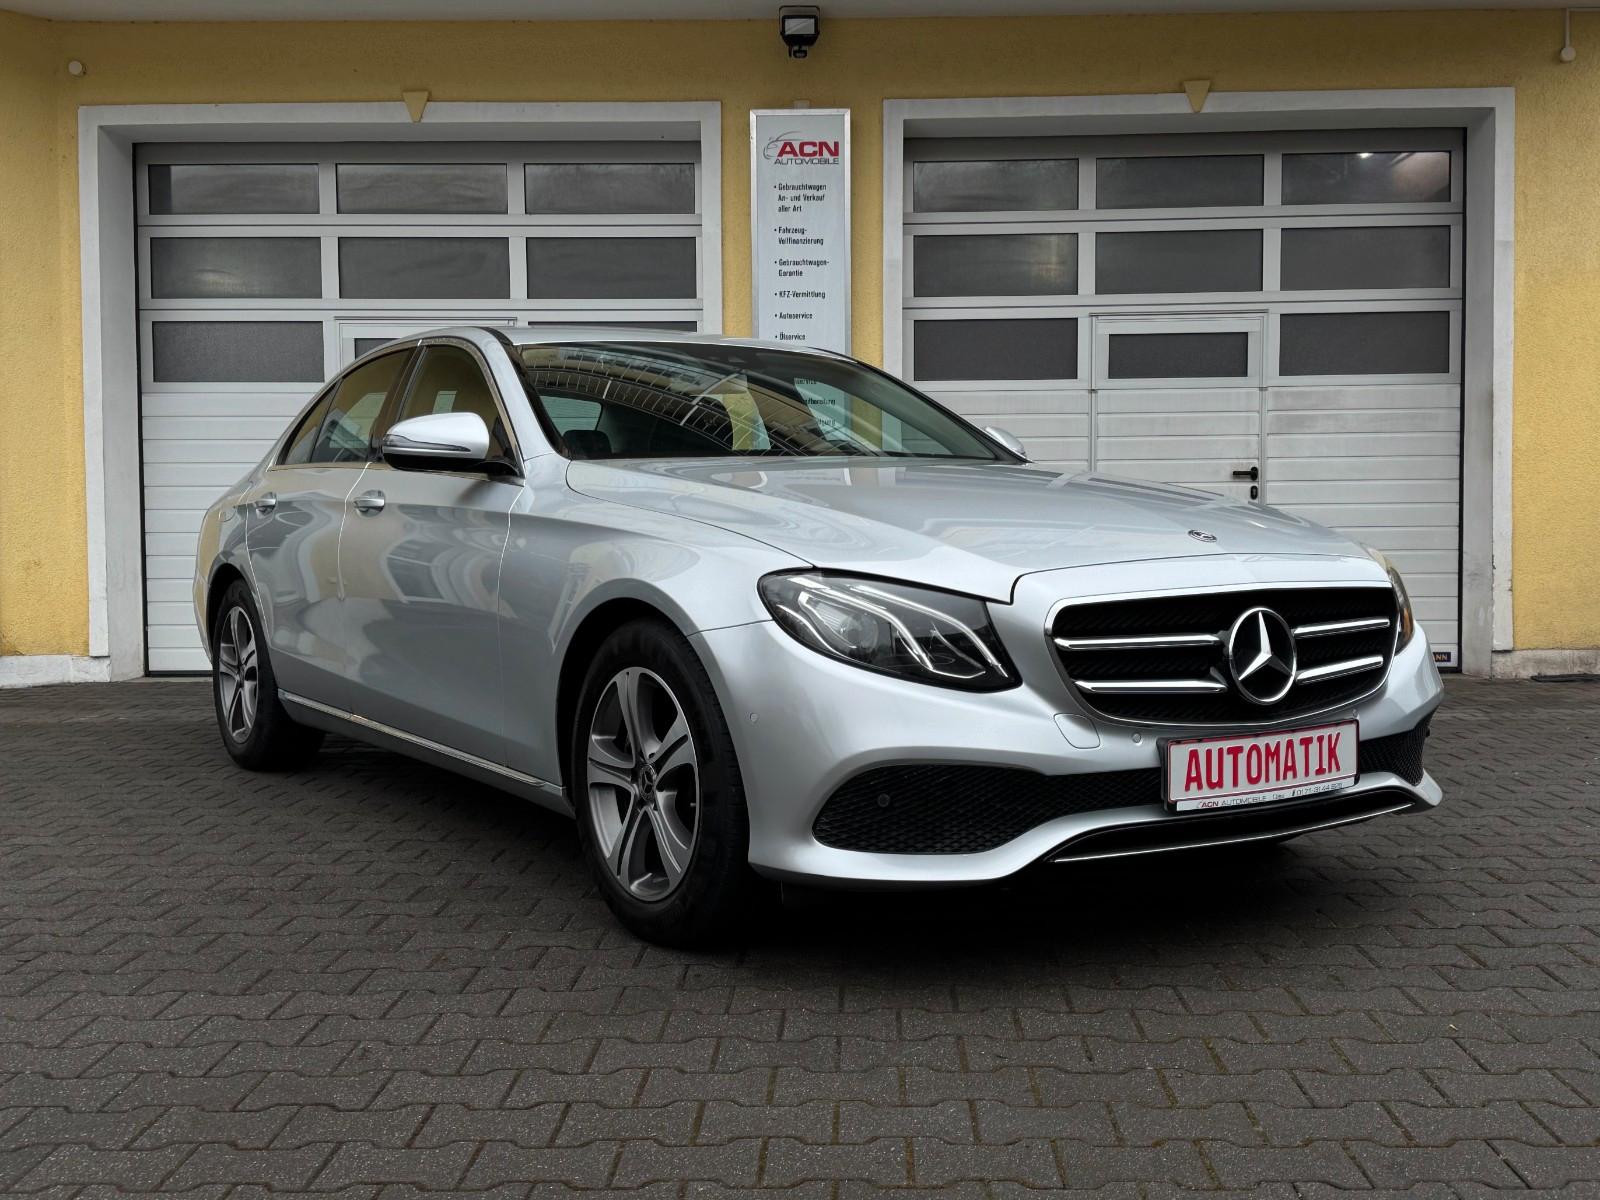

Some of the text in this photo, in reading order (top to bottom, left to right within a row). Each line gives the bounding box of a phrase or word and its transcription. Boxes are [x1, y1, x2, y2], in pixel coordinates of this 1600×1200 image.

[777, 141, 840, 157] ACN
[773, 157, 840, 165] AUTOMOBILE
[778, 182, 827, 192] Gebrauchtwagen
[777, 194, 825, 202] An- und Verkauf
[778, 226, 807, 235] Fahrzeug-
[778, 237, 824, 246] Vollfinanzierung
[778, 258, 830, 267] Gebrauchtwagen-
[778, 269, 803, 277] Garantie
[778, 290, 826, 299] KFZ-Vermittlung
[779, 312, 813, 320] Autoservice
[779, 332, 806, 340] Ölservice
[1184, 732, 1341, 792] AUTOMATIK
[1201, 800, 1219, 808] ACN
[1221, 795, 1267, 807] AUTOMOBILE
